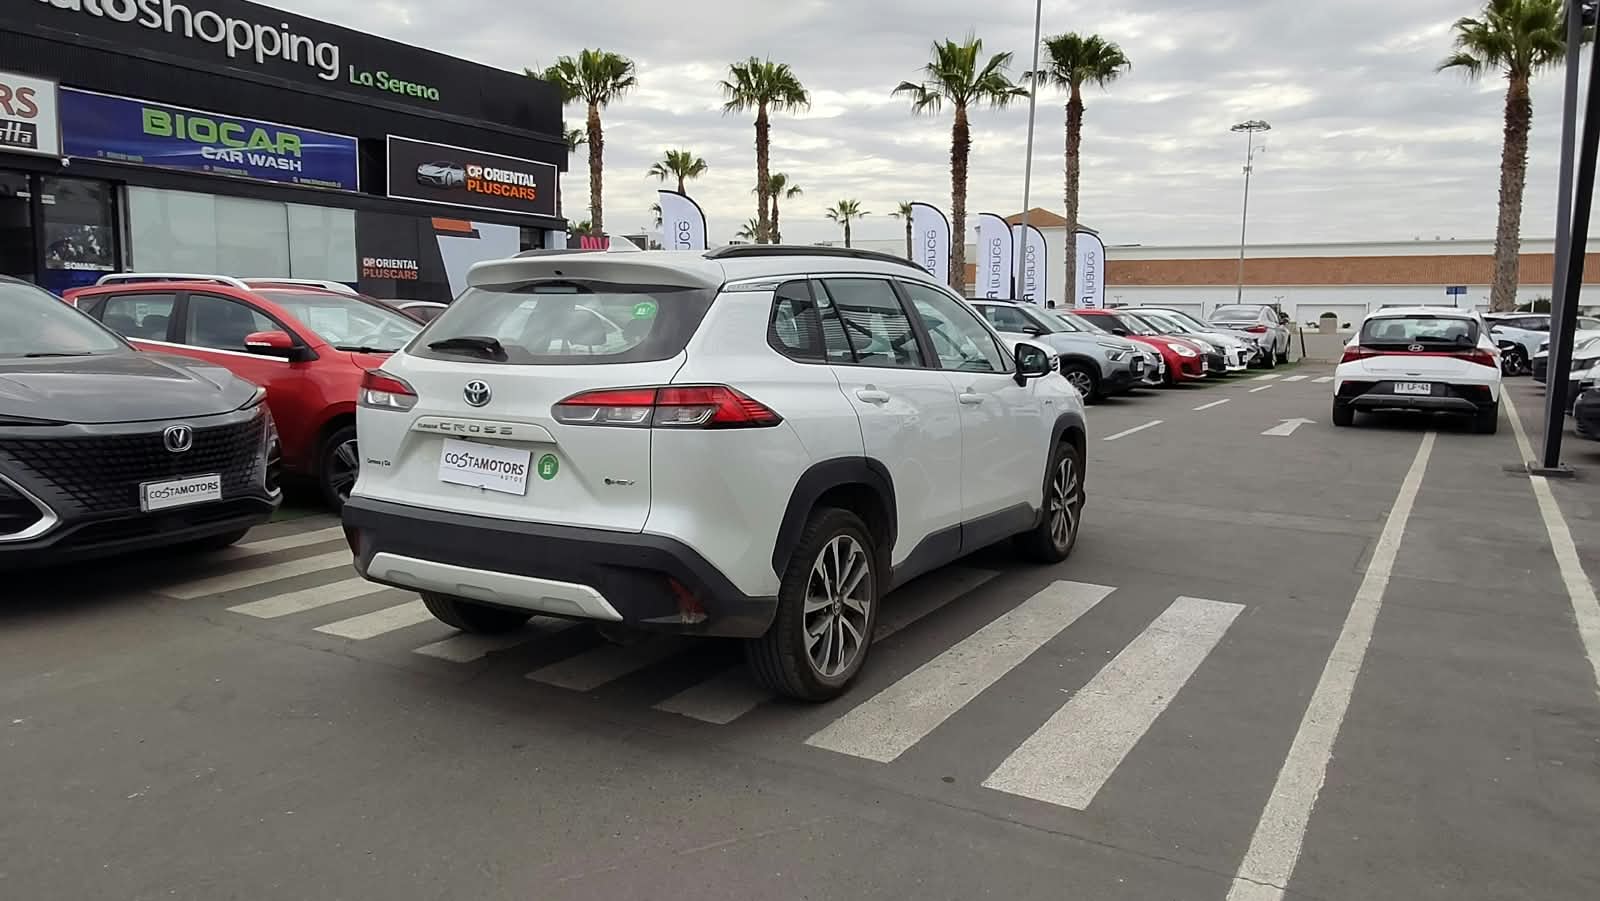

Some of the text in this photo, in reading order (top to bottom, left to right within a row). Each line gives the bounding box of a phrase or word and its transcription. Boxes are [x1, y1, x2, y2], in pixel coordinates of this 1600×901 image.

[349, 65, 440, 102] La Serena
[0, 121, 33, 144] tta
[142, 106, 303, 158] BIOCAR
[200, 145, 244, 165] CAR
[247, 152, 303, 172] WASH
[483, 167, 537, 187] ORIENTAL
[466, 180, 536, 200] PLUSCARS
[363, 268, 418, 280] PLUSCARS
[376, 258, 419, 270] ORIENTAL
[440, 422, 513, 435] CROSS
[444, 452, 525, 476] COSTAMOTORS
[149, 481, 219, 499] COSTAMOTORS
